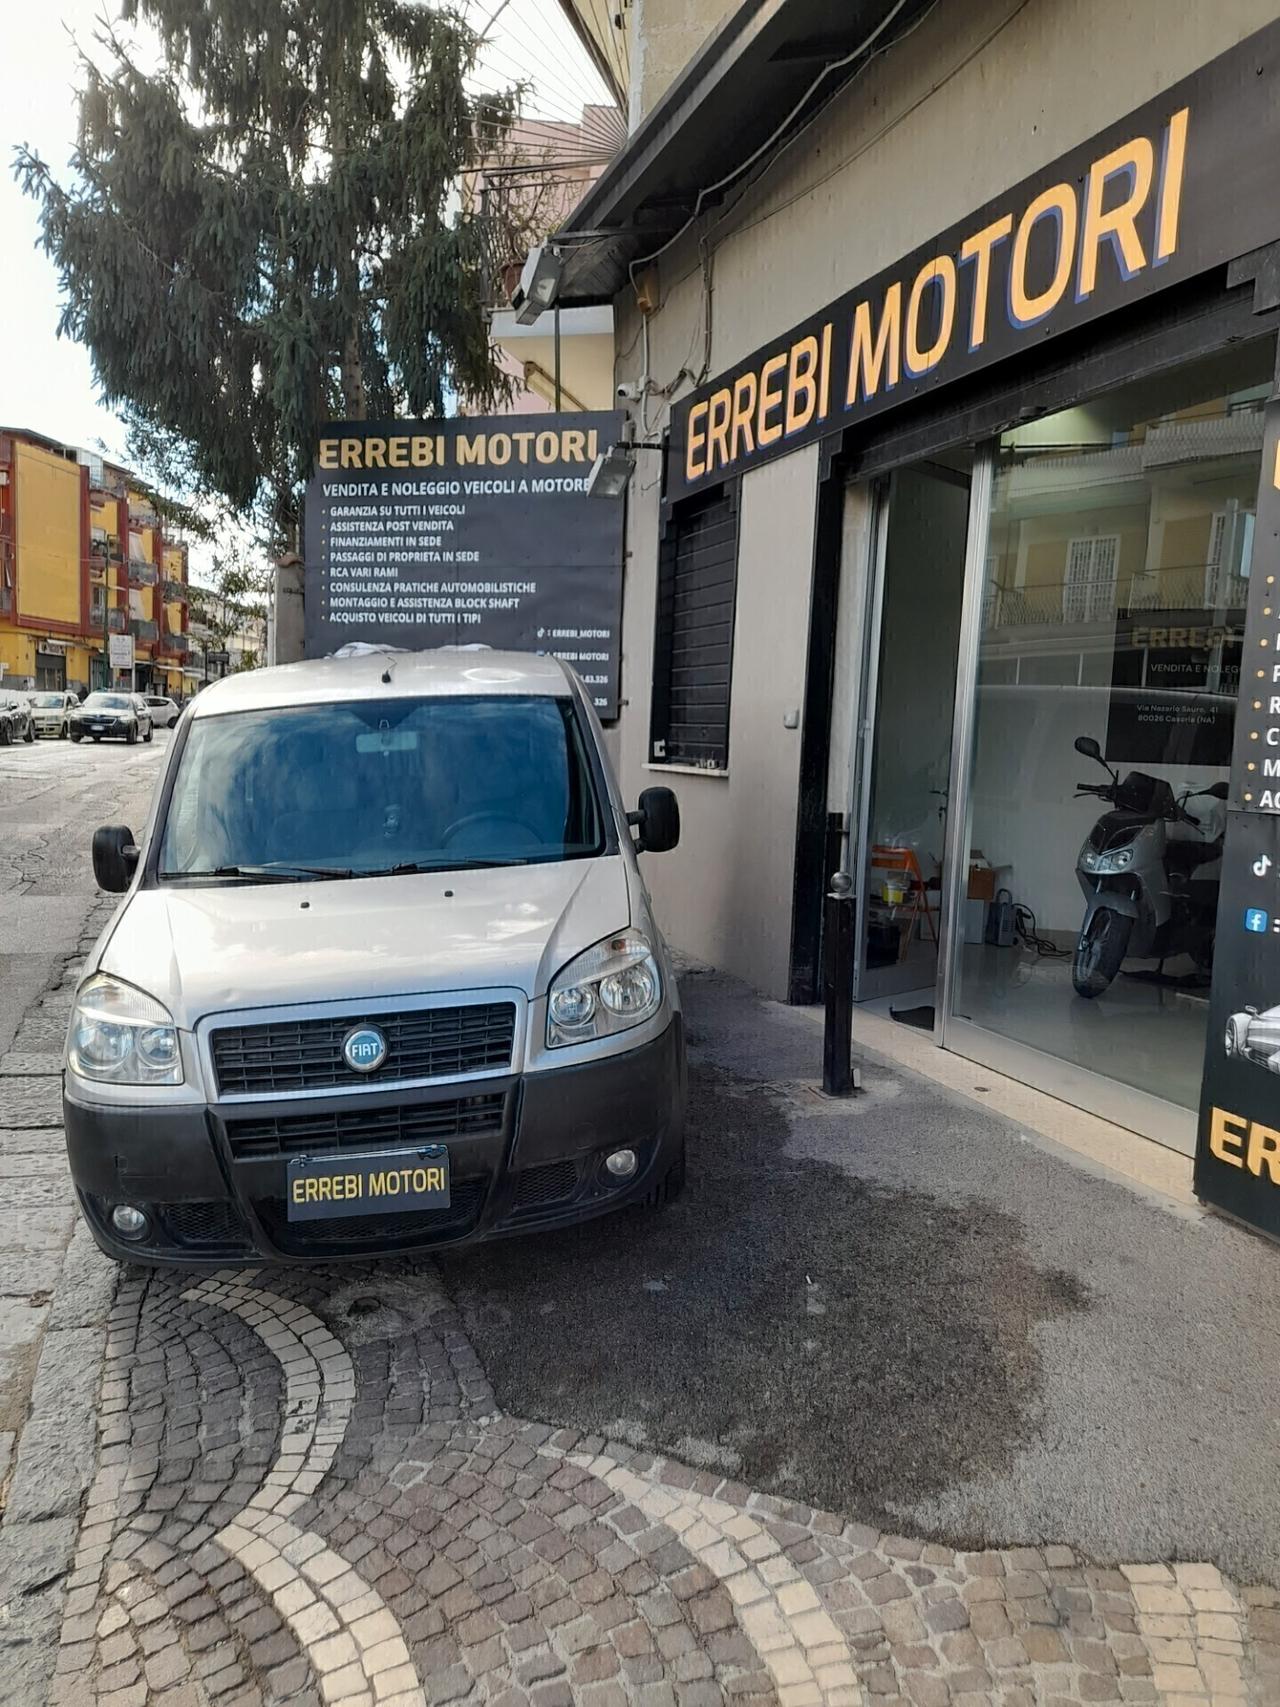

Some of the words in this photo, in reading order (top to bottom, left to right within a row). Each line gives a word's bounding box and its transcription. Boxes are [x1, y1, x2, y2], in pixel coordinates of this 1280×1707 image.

[685, 322, 833, 484] ERREBI
[846, 107, 1190, 410] MOTORI
[319, 435, 445, 469] ERREBI
[456, 429, 598, 466] MOTORI
[322, 483, 378, 497] VENDITA
[381, 482, 388, 496] E
[391, 481, 460, 496] NOLEGGIO
[463, 480, 515, 494] VEICOLI
[518, 479, 529, 493] A
[531, 478, 590, 493] MOTORE
[330, 505, 378, 517] GARANZIA
[379, 505, 392, 516] SU
[394, 505, 421, 516] TUTTI
[422, 505, 427, 515] I
[428, 504, 466, 515] VEICOLI
[330, 521, 384, 532] ASSISTENZA
[386, 521, 410, 531] POST
[412, 520, 454, 531] VENDITA
[330, 536, 404, 547] FINANZIAMENTI
[405, 536, 417, 547] IN
[418, 536, 442, 547] SEDE
[330, 551, 375, 562] PASSAGGI
[376, 552, 387, 562] DI
[443, 551, 454, 562] IN
[455, 551, 480, 562] SEDE
[330, 567, 349, 578] RCA
[350, 567, 372, 577] VARI
[373, 567, 399, 577] RAMI
[330, 582, 392, 593] CONSULENZA
[393, 582, 439, 593] PRATICHE
[440, 582, 537, 593] AUTOMOBILISTICHE
[330, 597, 388, 608] MONTAGGIO
[390, 598, 396, 608] E
[397, 598, 453, 608] ASSISTENZA
[454, 598, 487, 609] BLOCK
[488, 598, 520, 609] SHAFT
[329, 612, 377, 624] ACQUISTO
[378, 612, 414, 623] VEICOLI
[416, 613, 427, 623] DI
[428, 613, 455, 623] TUTTI
[462, 613, 481, 624] TIPI
[579, 652, 609, 661] MOTORI
[1151, 663, 1192, 673] VENDITA
[1195, 664, 1203, 673] E
[1204, 664, 1241, 673] NOLEG
[352, 1043, 377, 1057] FIAT
[293, 1174, 363, 1204] ERREBI
[368, 1167, 445, 1197] MOTORI
